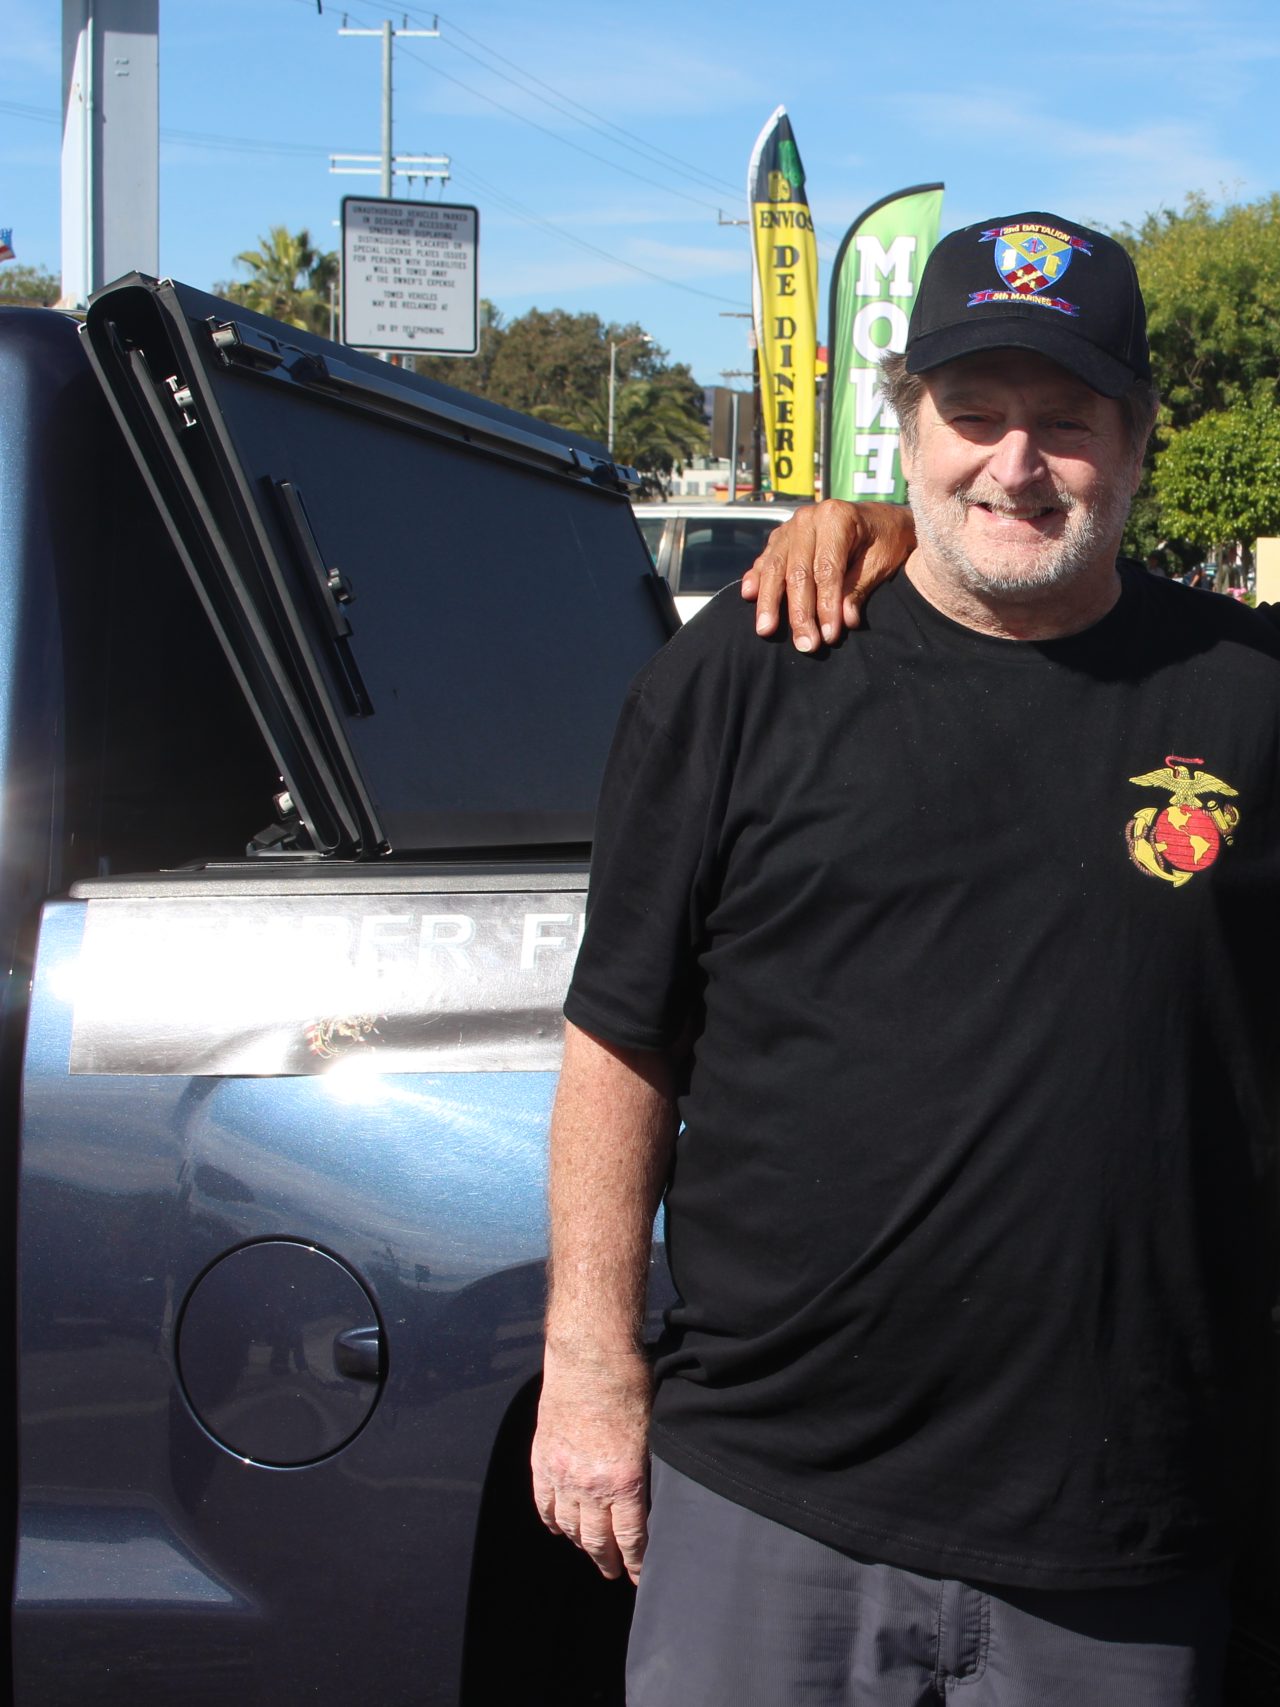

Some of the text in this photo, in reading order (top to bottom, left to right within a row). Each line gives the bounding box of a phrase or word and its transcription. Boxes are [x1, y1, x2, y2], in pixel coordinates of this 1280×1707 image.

[759, 210, 814, 232] ENVIOS
[1004, 224, 1071, 242] 2nd BATTALION
[773, 245, 800, 297] DE
[773, 317, 797, 479] DINERO
